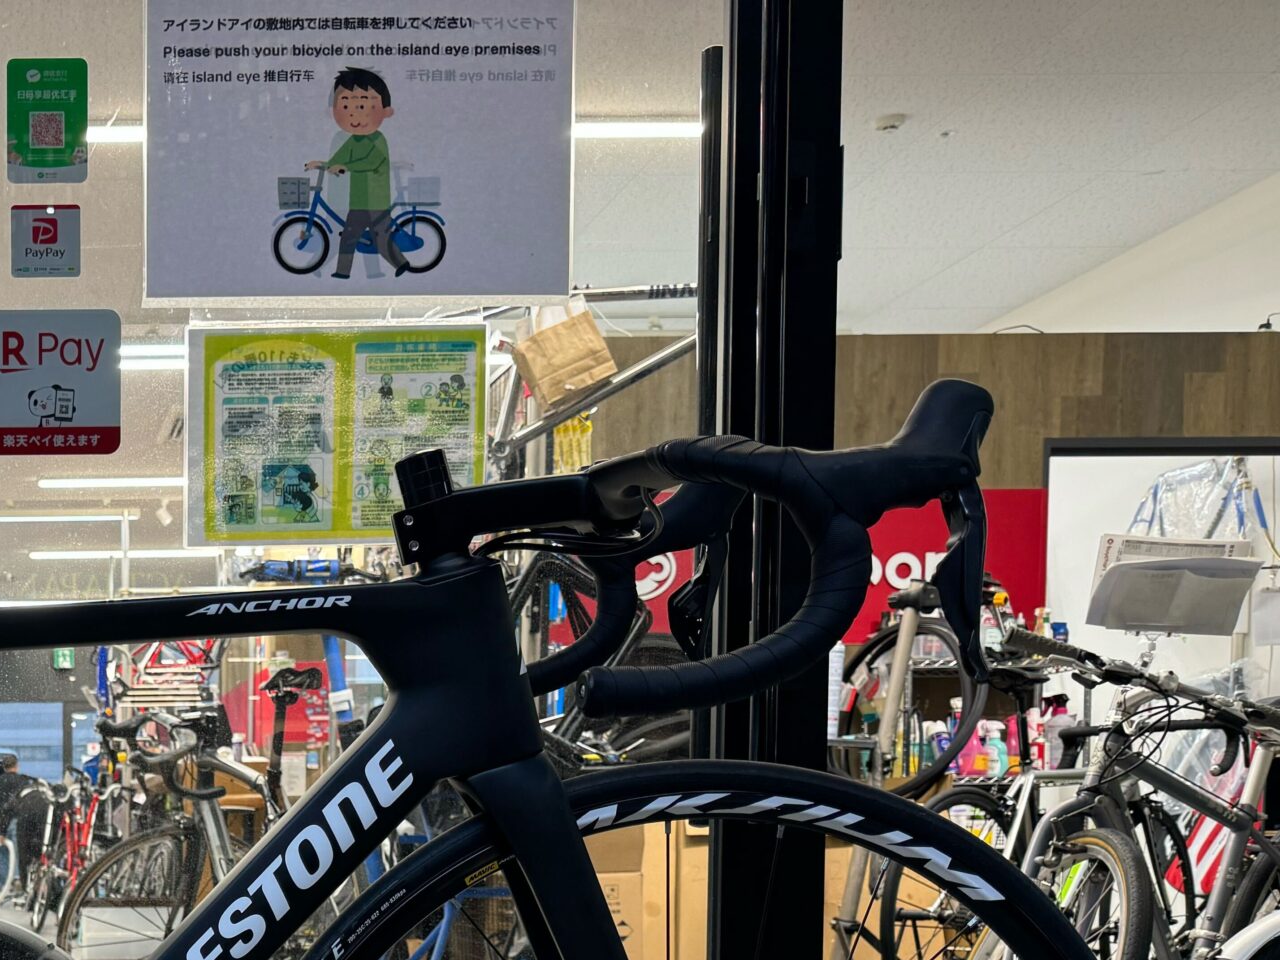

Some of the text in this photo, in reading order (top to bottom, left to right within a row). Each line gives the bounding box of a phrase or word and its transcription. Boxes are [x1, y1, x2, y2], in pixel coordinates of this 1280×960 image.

[162, 16, 473, 31] アイランドアイの敷地内では自転車を押してください
[163, 46, 210, 58] Please
[215, 45, 250, 58] push
[255, 46, 287, 58] your
[292, 44, 343, 58] bicycle
[347, 46, 364, 56] on
[370, 44, 393, 56] the
[397, 43, 440, 55] island
[444, 46, 470, 57] eye
[474, 43, 541, 57] premises
[163, 70, 314, 84] 请在 island eye 推自行车
[25, 247, 66, 260] PayPay
[38, 332, 105, 372] Pay
[3, 434, 100, 447] 楽天ペイ使えます
[185, 594, 352, 616] ANCHOR
